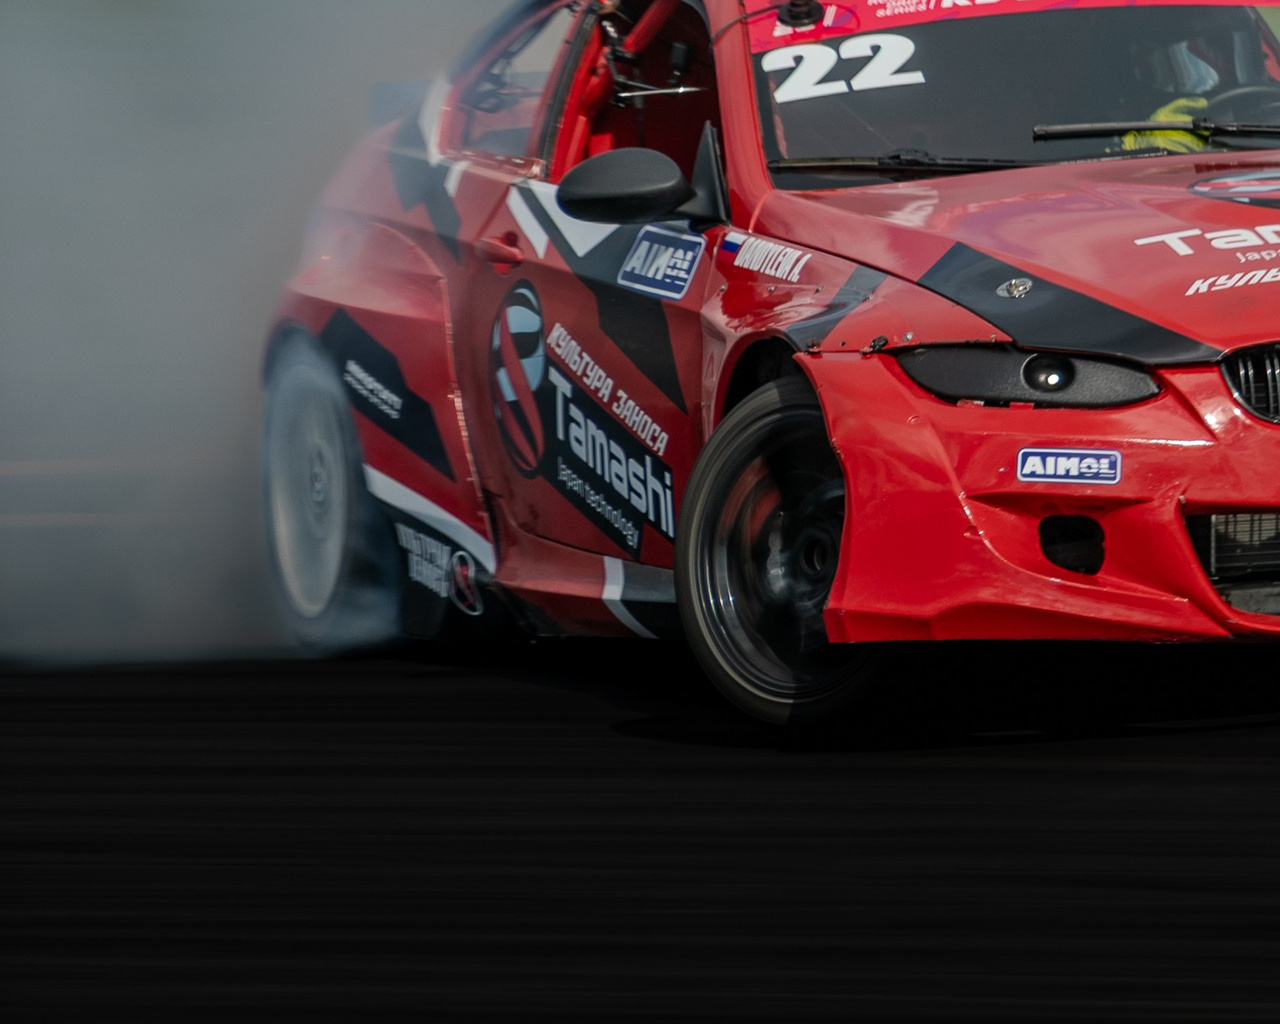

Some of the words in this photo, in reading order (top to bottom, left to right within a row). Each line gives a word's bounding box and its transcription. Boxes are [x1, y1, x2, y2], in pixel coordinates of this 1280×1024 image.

[876, 2, 927, 17] SERIES
[761, 33, 926, 104] 22
[624, 240, 695, 286] AIMOL
[546, 322, 614, 403] КУЛЬТУРА
[611, 389, 669, 457] ЗАНОСА
[548, 365, 674, 539] Tamashi
[1021, 455, 1116, 478] AIMOL
[584, 481, 640, 550] technology
